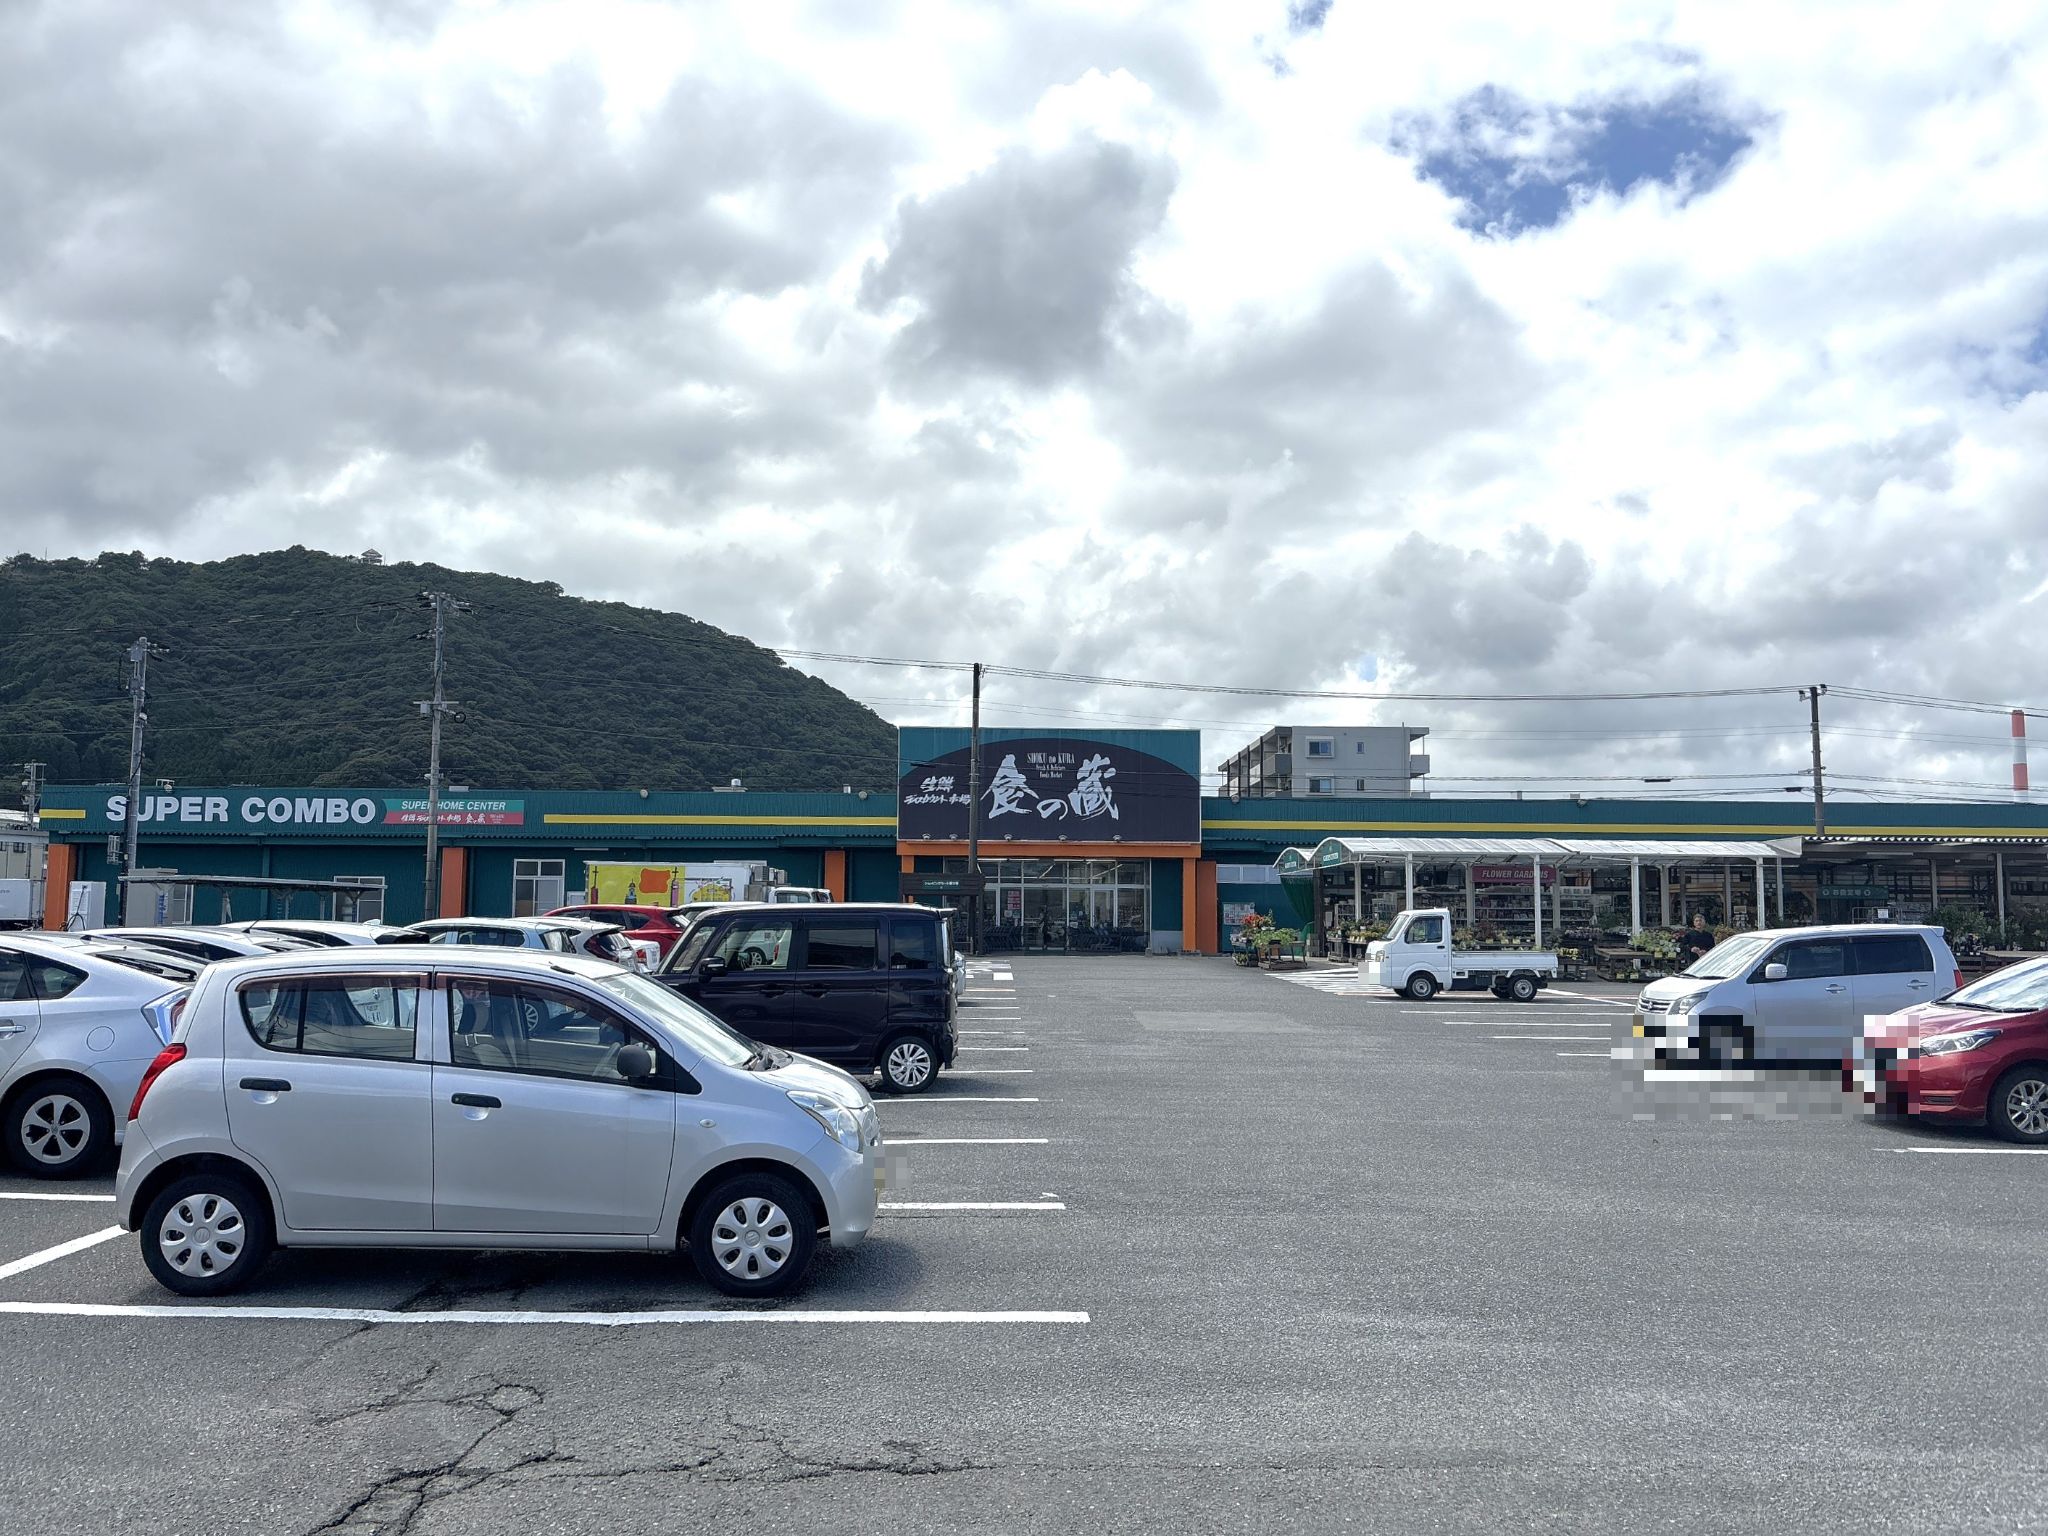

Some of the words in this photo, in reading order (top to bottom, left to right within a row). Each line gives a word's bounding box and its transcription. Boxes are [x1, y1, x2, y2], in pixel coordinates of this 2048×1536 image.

[1058, 752, 1075, 764] KURA
[980, 753, 1119, 821] 食の蔵
[106, 796, 229, 822] SUPER
[241, 797, 376, 824] COMBO
[402, 800, 431, 810] SUPE
[437, 801, 465, 810] HOME
[467, 801, 506, 811] CENTER
[1482, 869, 1512, 878] FLOWER
[1514, 869, 1549, 878] GARDS
